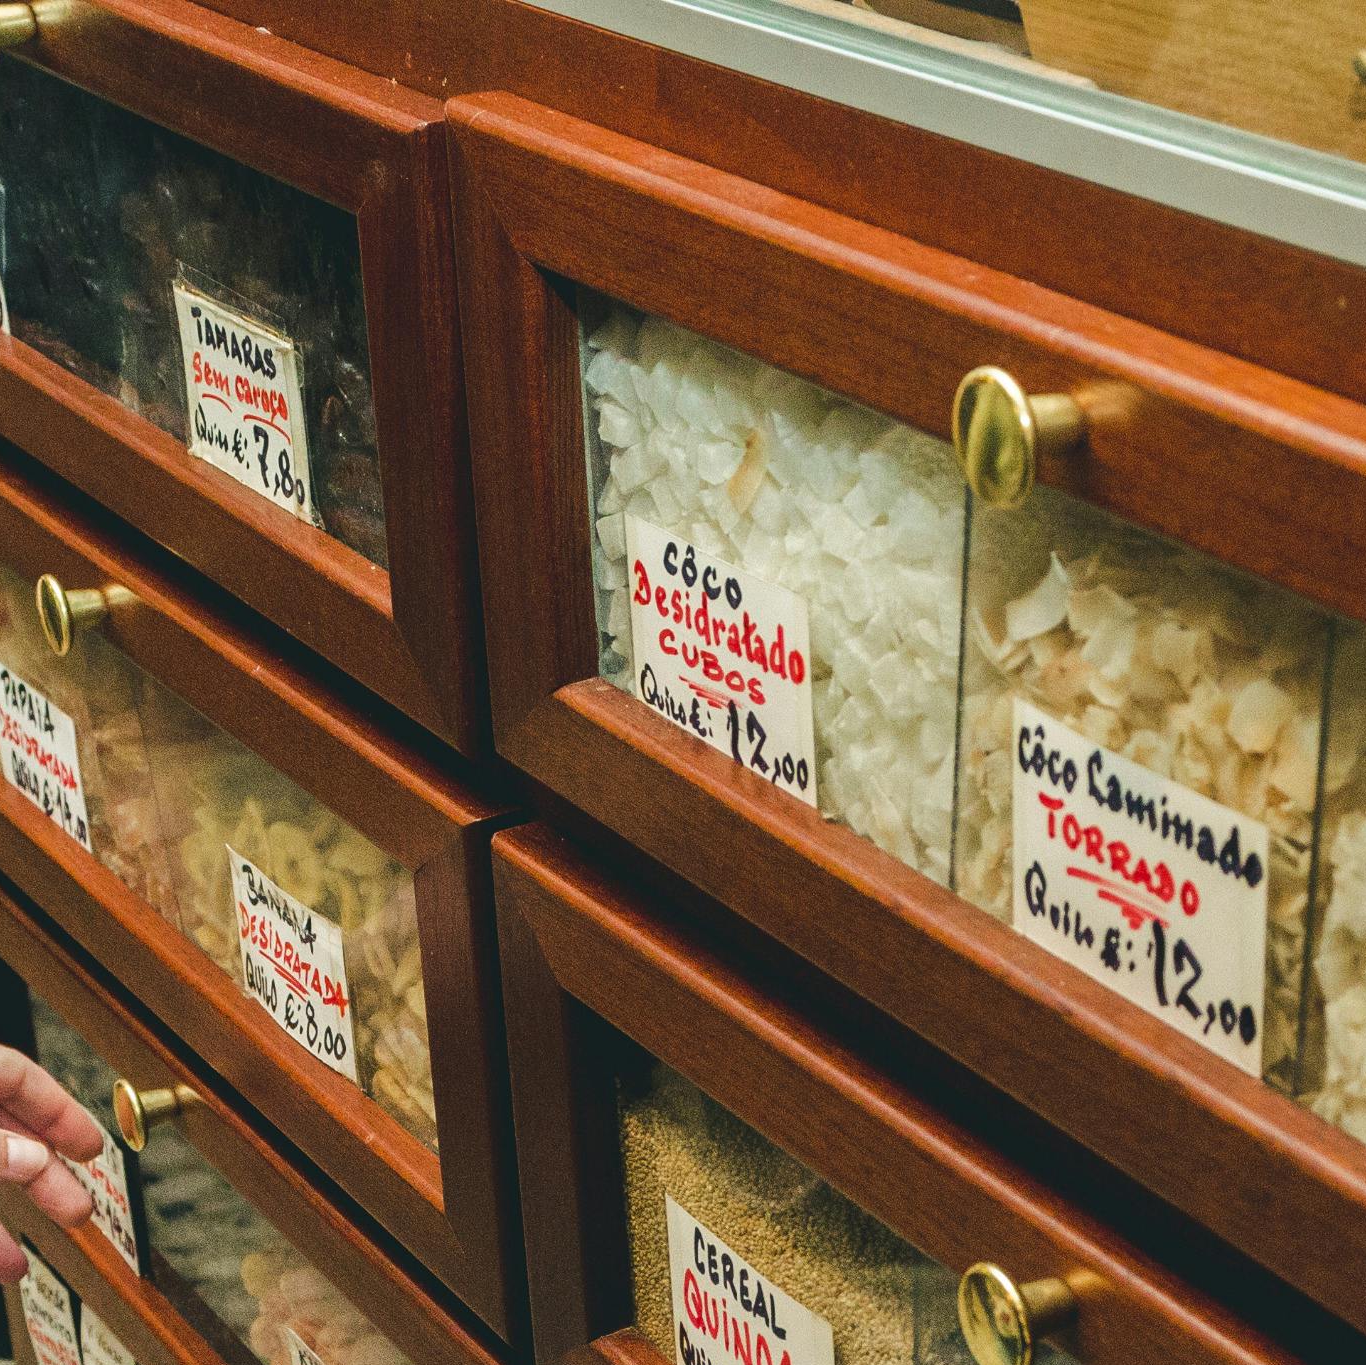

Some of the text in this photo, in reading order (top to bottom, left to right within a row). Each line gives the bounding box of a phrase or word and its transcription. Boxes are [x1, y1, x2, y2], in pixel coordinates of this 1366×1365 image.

[633, 560, 806, 685] Desidratado
[659, 632, 766, 706] CUBOS
[1025, 861, 1095, 951] Quilo
[1037, 792, 1200, 917] TORRADO
[241, 863, 317, 956] BANANA
[692, 1225, 787, 1341] CEREAL
